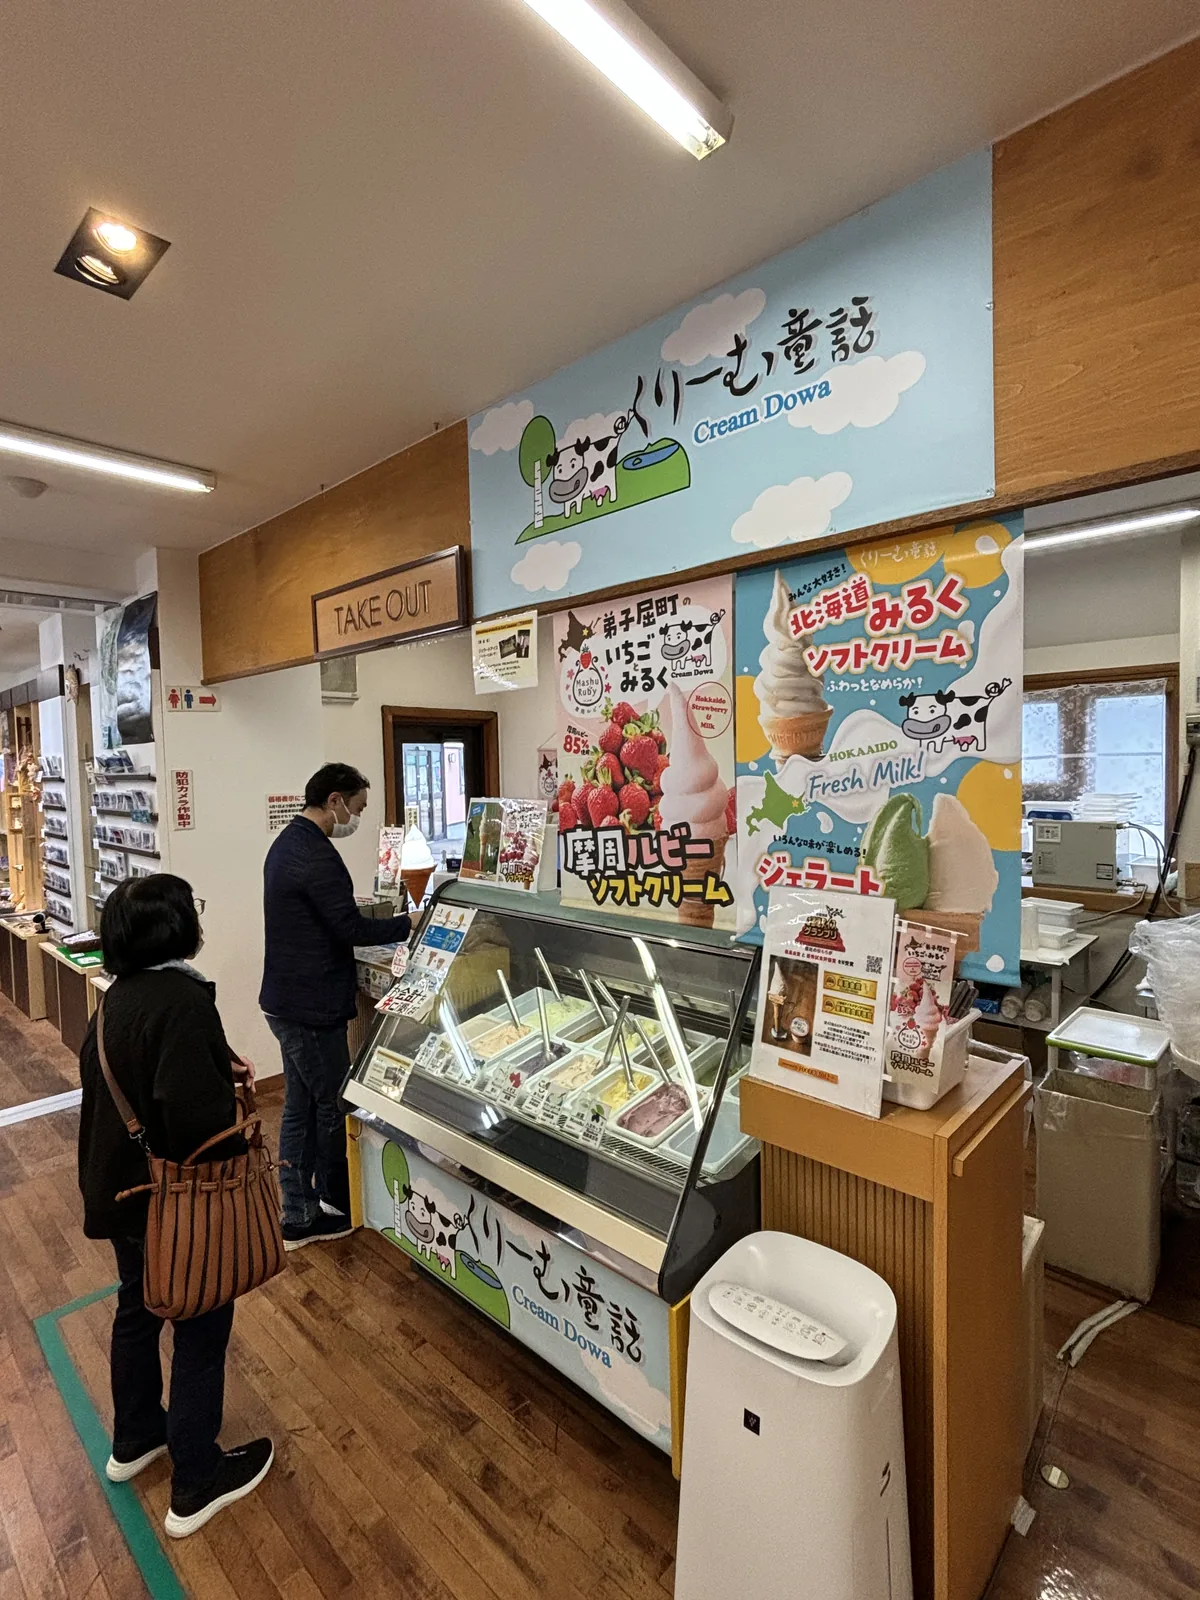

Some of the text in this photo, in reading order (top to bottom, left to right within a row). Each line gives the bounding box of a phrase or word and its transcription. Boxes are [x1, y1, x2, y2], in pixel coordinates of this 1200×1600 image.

[631, 296, 879, 438] くりーむ童話
[694, 378, 832, 444] Cream Dowa
[334, 579, 432, 636] TAKE OUT
[605, 633, 655, 666] いちご
[807, 635, 967, 672] ソフトクリーム
[576, 677, 600, 687] Mashu
[620, 665, 669, 694] みるく
[632, 662, 640, 672] と
[671, 667, 714, 679] Cream Dowa
[578, 688, 598, 697] Ruby
[695, 695, 726, 705] Hokkaido
[826, 676, 923, 693] ふわっとなめらか!
[691, 703, 729, 715] Strawberry
[700, 721, 715, 730] Milk
[563, 735, 589, 755] 85%
[829, 740, 898, 763] HOKAAIDO
[808, 751, 925, 799] Fresh Milk!
[175, 771, 191, 828] 防犯カメラ作動中
[564, 823, 714, 877] 摩周ルビー
[773, 834, 867, 859] いろんな味が楽しめる!
[589, 872, 733, 907] ソフトクリーム
[758, 855, 880, 896] ジェラート
[468, 1193, 643, 1363] くりーむ童話
[511, 1284, 613, 1369] Cream Dowa
